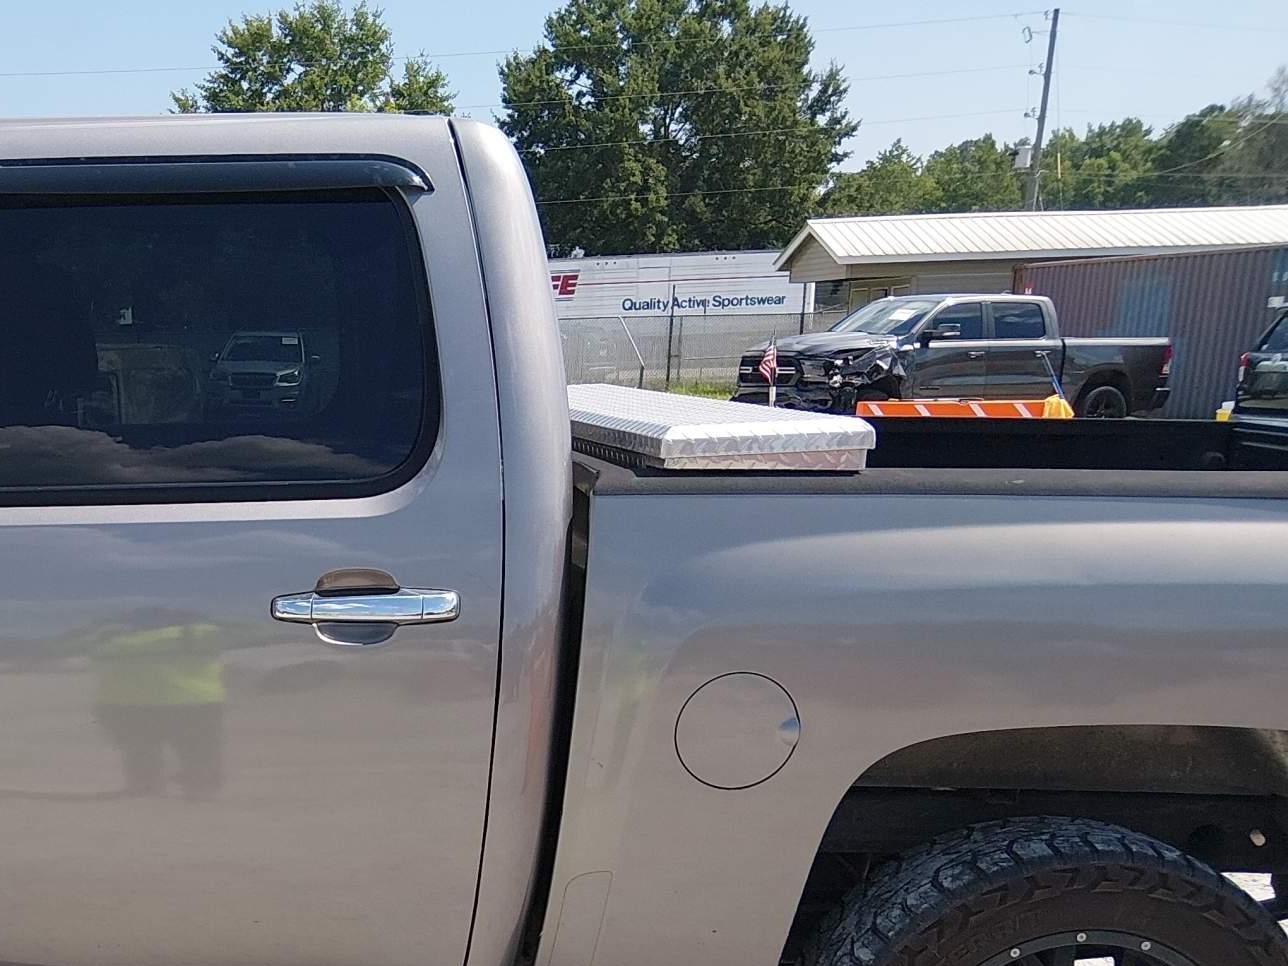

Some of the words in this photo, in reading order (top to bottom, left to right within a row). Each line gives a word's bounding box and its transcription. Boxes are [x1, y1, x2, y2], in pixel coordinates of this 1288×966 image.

[622, 297, 669, 312] Quality
[672, 295, 710, 309] Active
[712, 295, 786, 310] Sportswear
